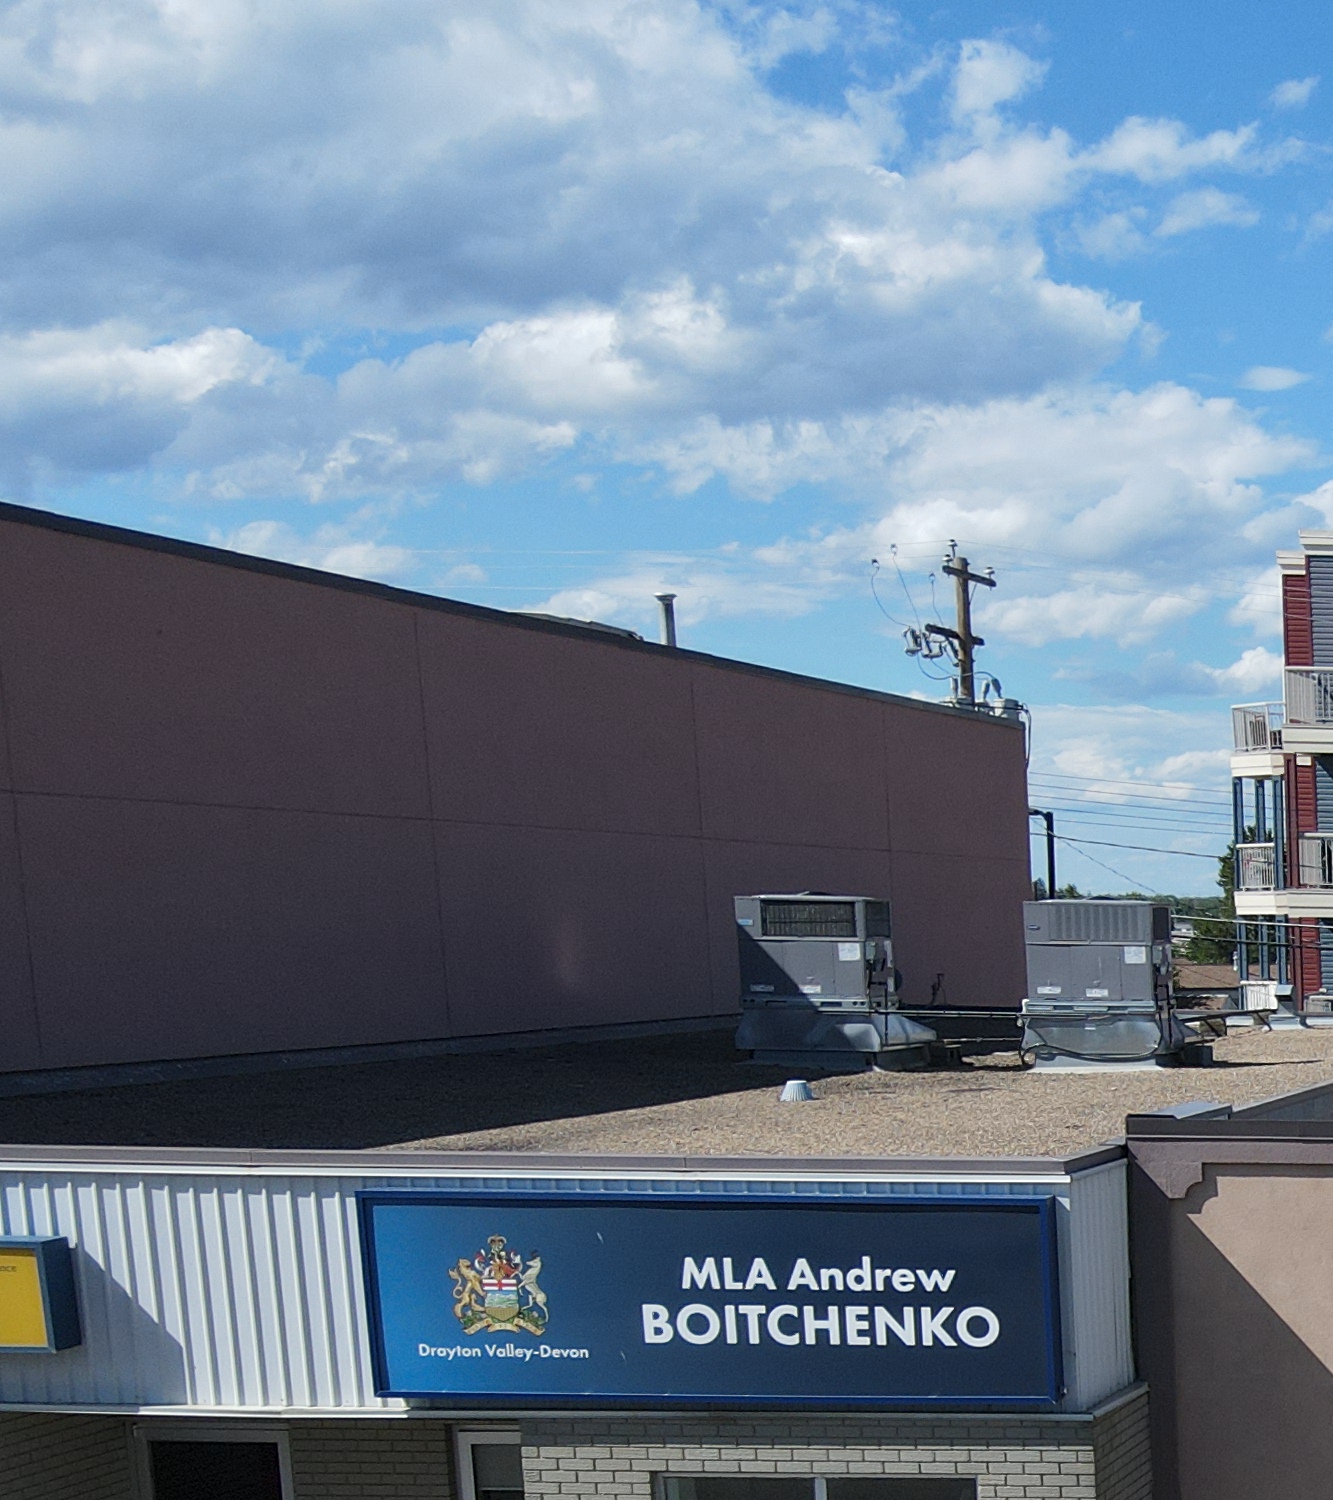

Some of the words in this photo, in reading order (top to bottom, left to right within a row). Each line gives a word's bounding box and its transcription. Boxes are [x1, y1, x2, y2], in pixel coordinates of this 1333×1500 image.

[681, 1256, 777, 1291] MLA
[788, 1254, 956, 1294] Andrew
[641, 1302, 1001, 1349] BOITCHENKO
[417, 1343, 482, 1362] Drayton
[484, 1342, 589, 1362] Valley-Devon
